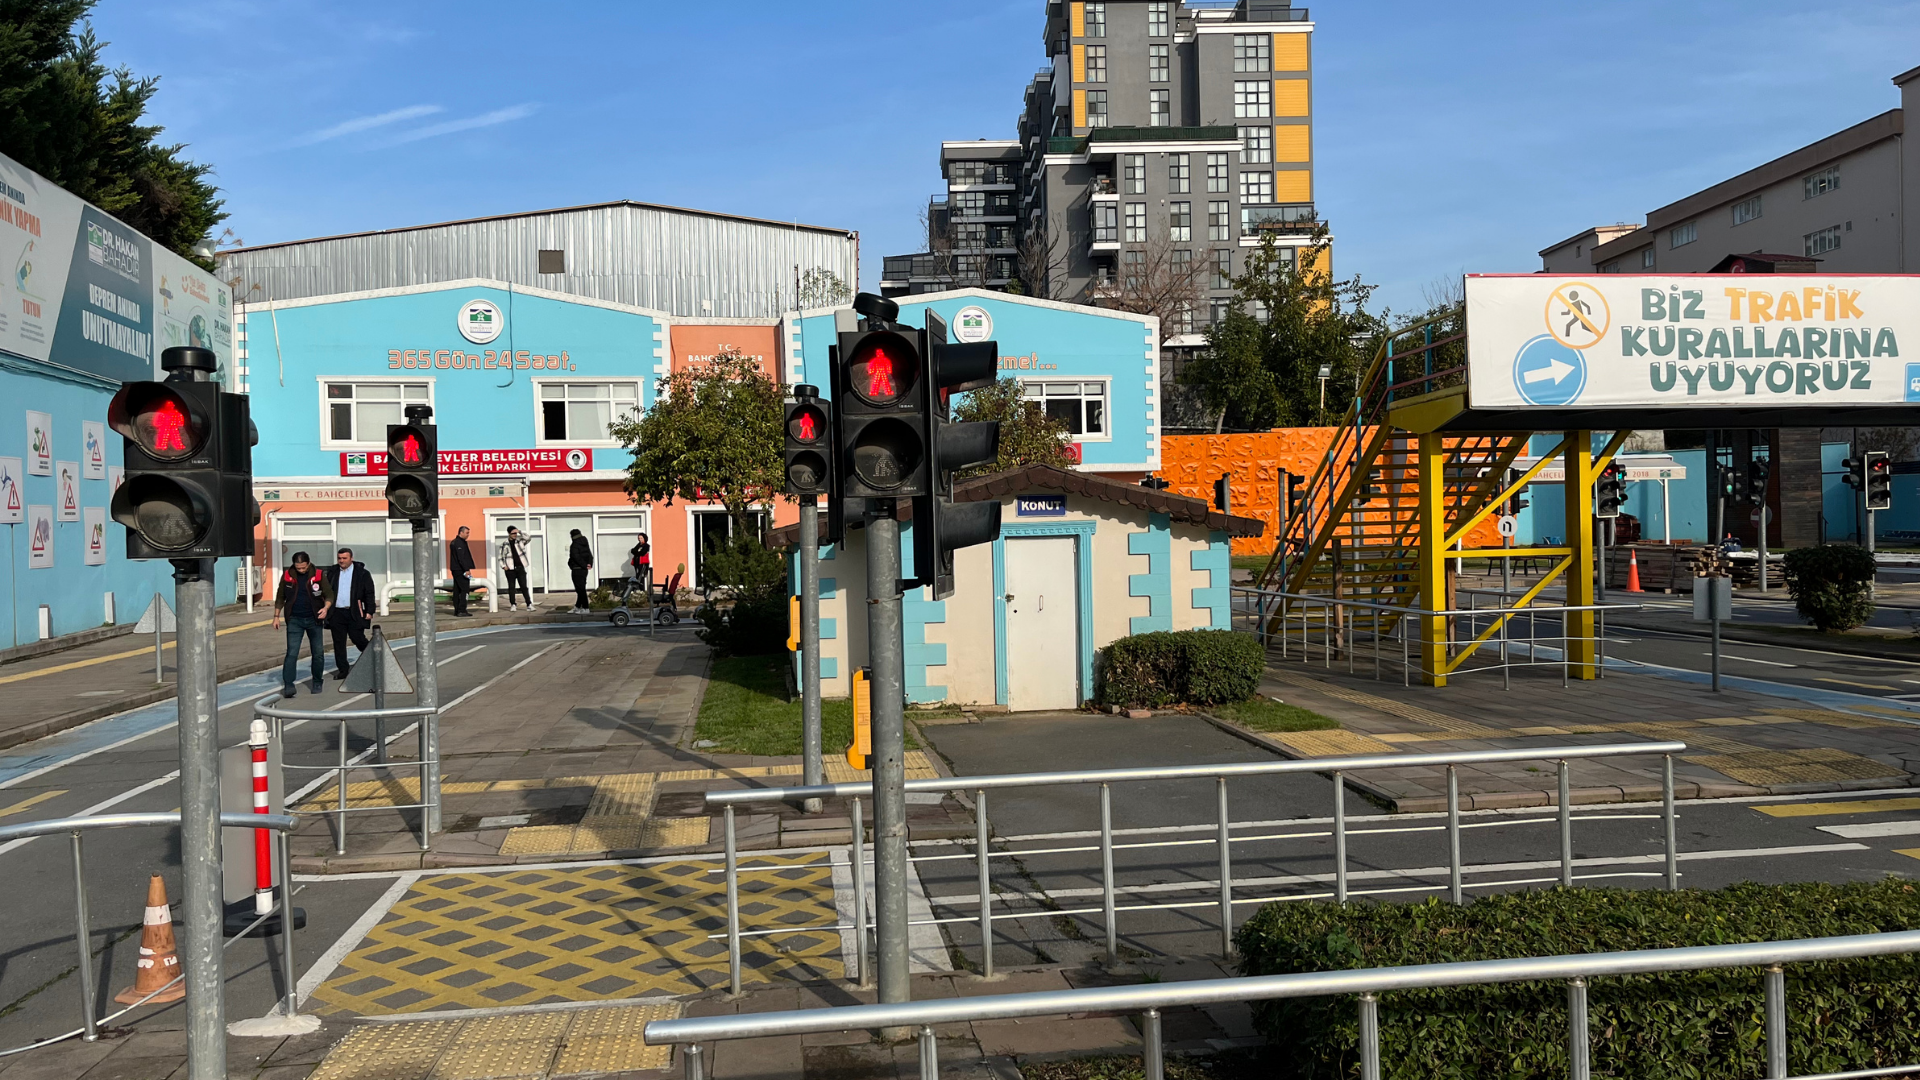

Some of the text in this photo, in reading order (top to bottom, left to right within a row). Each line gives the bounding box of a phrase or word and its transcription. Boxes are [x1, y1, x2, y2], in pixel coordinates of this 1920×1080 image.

[0, 197, 41, 238] NİK YAPMA
[103, 228, 139, 261] DR. HAKAN
[103, 245, 139, 277] BAHADIR
[23, 299, 41, 318] TUTUN
[89, 283, 140, 323] DEPREM ANINDA
[1641, 284, 1864, 323] BİZ TRAFİK
[1621, 325, 1899, 360] KURALLARINA
[388, 349, 432, 369] 365
[484, 350, 512, 369] 24
[997, 352, 1057, 370] zmet...
[1650, 360, 1871, 395] UYUYORUZ
[453, 462, 493, 472] EĞİTİM
[496, 463, 530, 471] PARKI
[482, 450, 561, 462] BELEDİYESİ
[454, 488, 476, 496] 2018
[1021, 501, 1061, 511] KONUT
